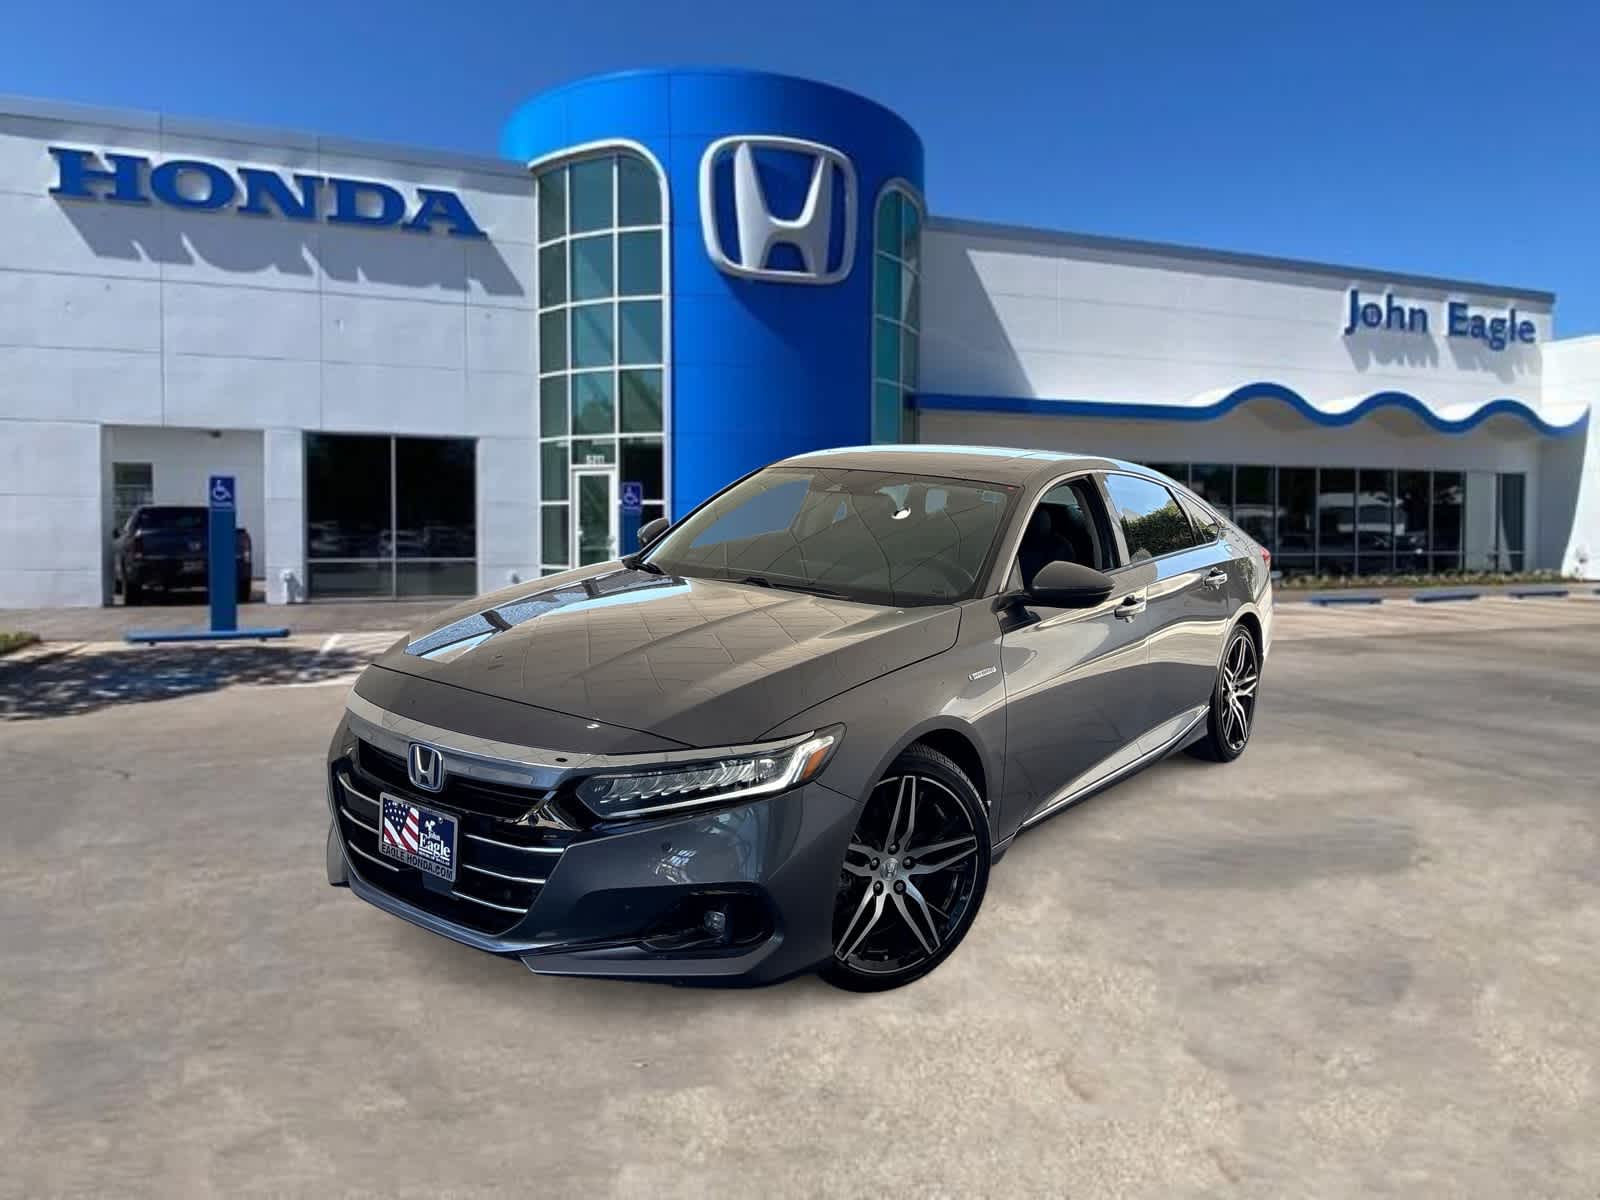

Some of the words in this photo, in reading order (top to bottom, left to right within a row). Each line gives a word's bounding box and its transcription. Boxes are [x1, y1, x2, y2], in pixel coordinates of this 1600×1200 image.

[48, 146, 490, 240] HONDA
[1344, 289, 1428, 336] John
[1447, 302, 1537, 351] Eagle
[382, 844, 405, 861] EAGLE
[406, 853, 453, 880] HONDA.COM
[419, 832, 451, 857] Eagle
